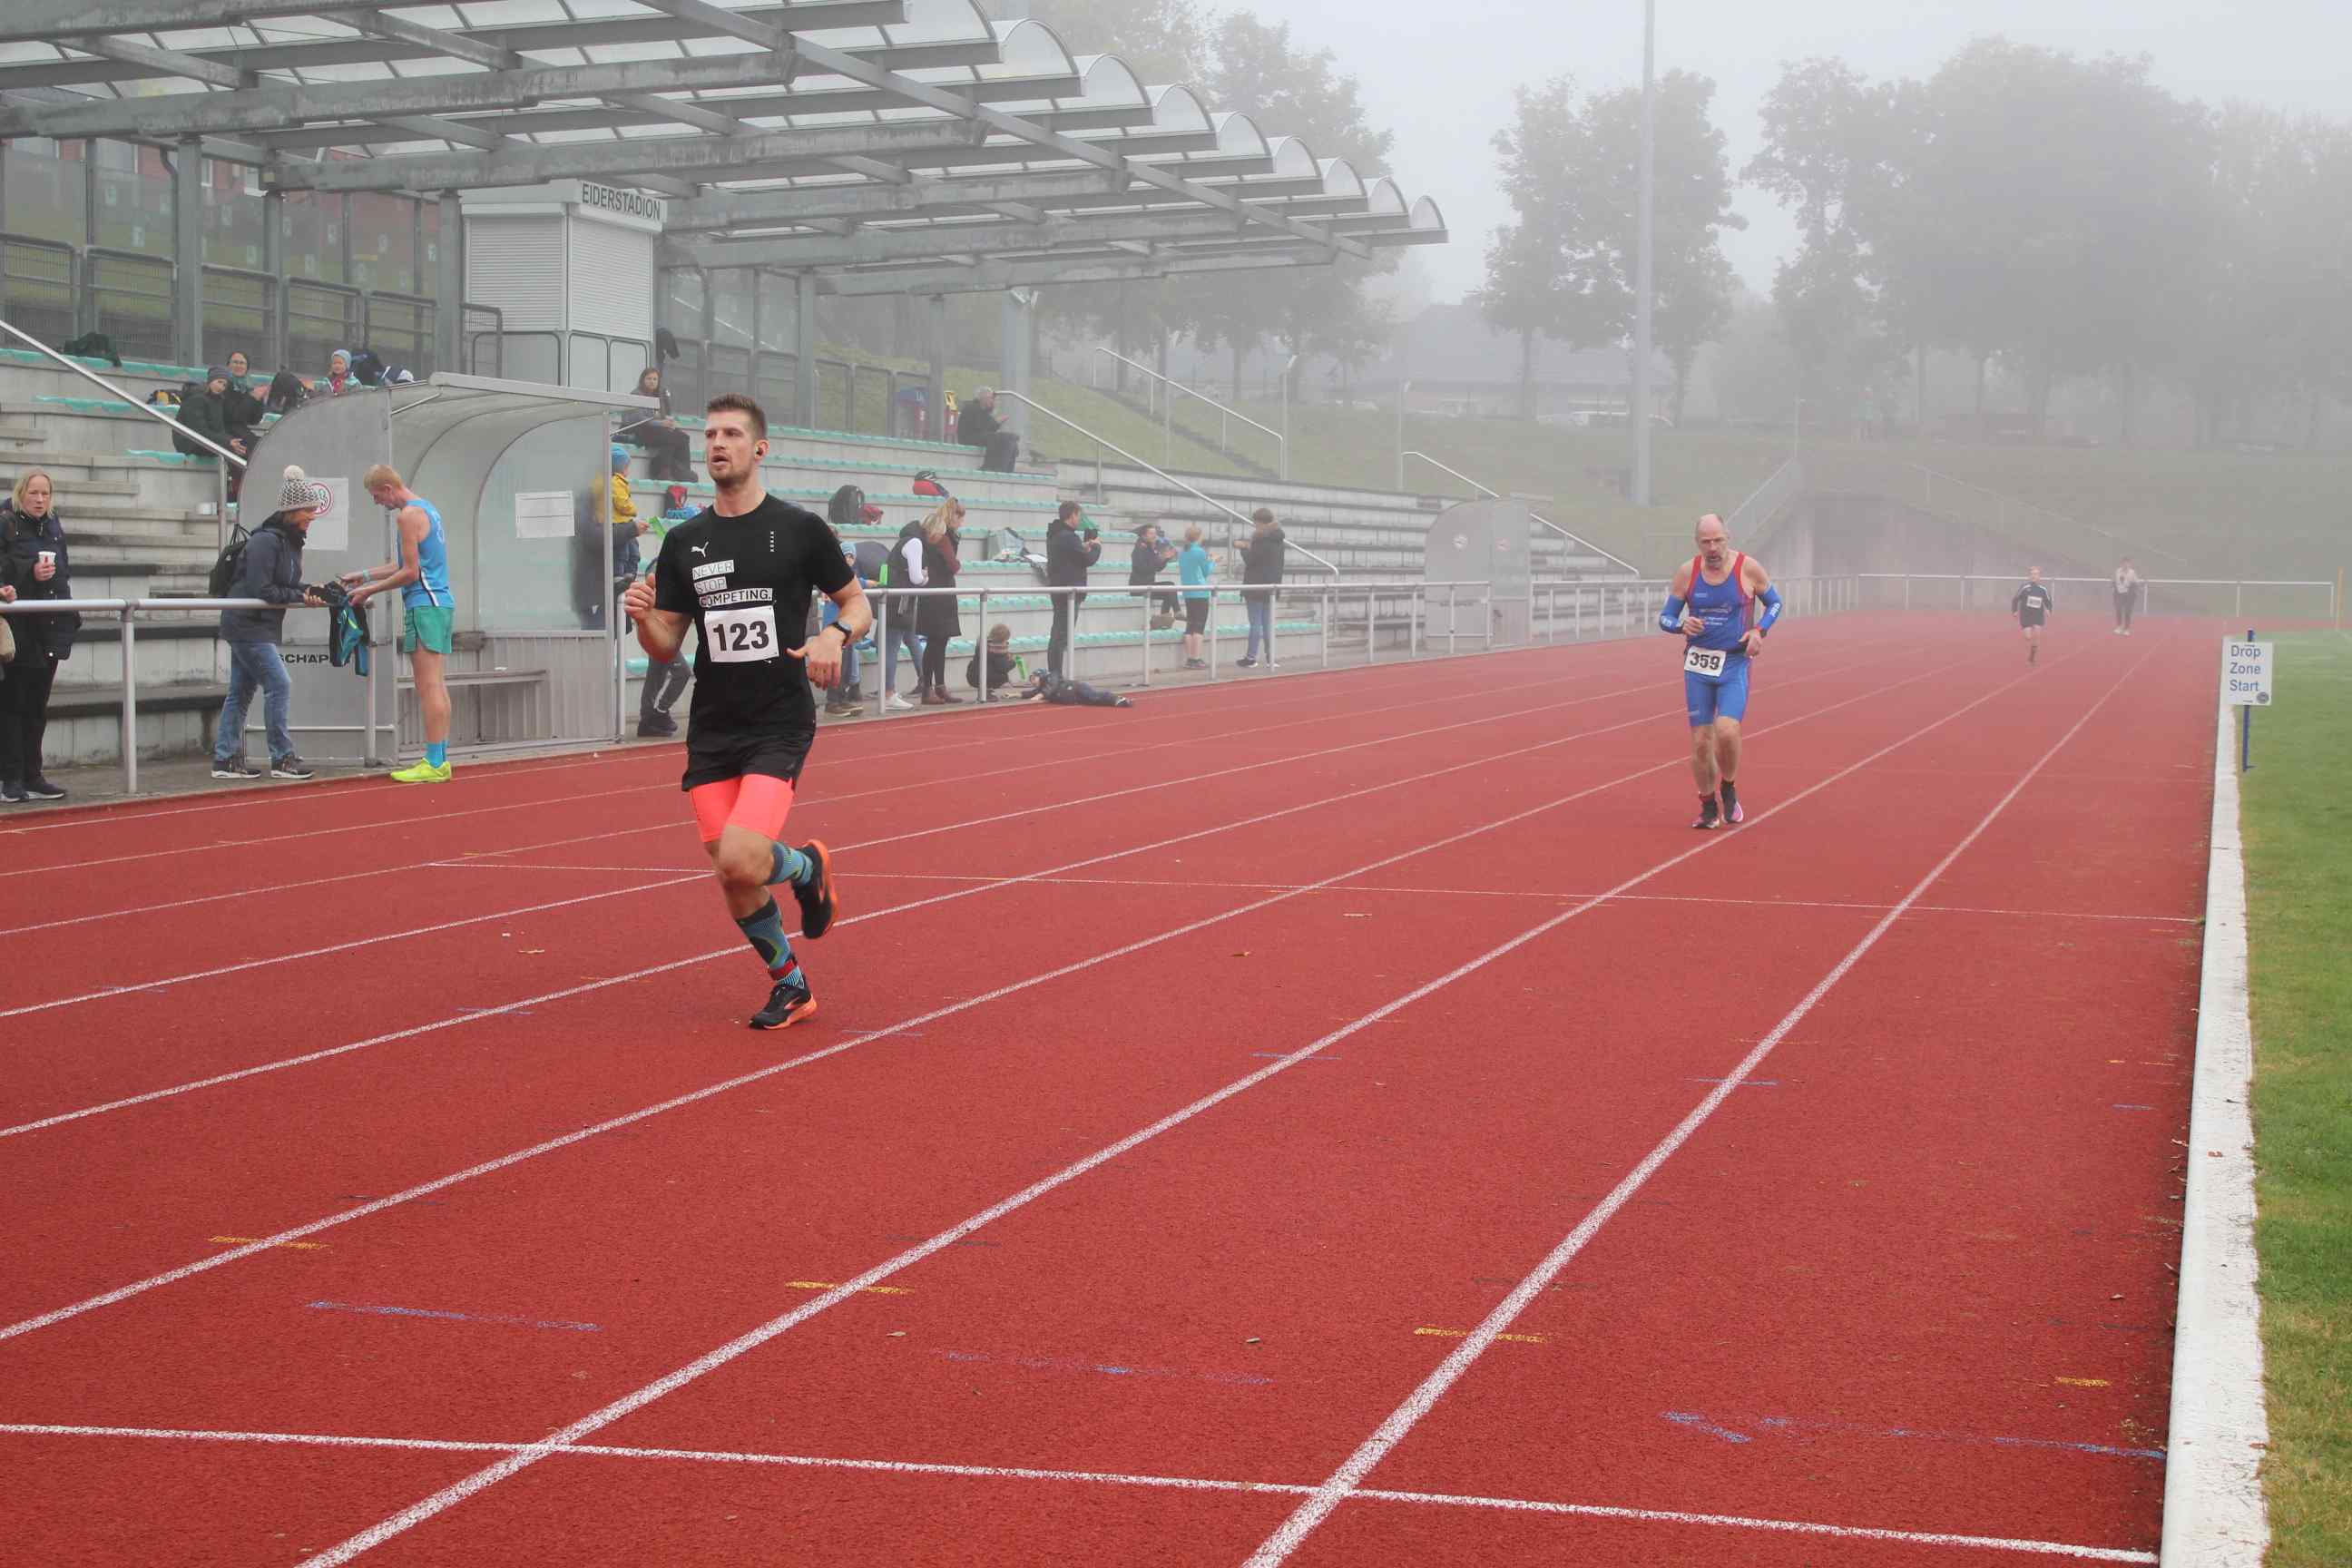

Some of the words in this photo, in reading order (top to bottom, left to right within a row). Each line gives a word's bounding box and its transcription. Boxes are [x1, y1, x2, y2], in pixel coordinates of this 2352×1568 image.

[582, 182, 661, 220] EIDERSTADION
[693, 563, 733, 578] NEVER
[695, 578, 726, 594] STOP
[713, 621, 769, 652] 123
[2230, 644, 2261, 660] Drop
[1690, 652, 1721, 670] 359
[2230, 662, 2261, 674] Zone
[2230, 679, 2259, 691] Start
